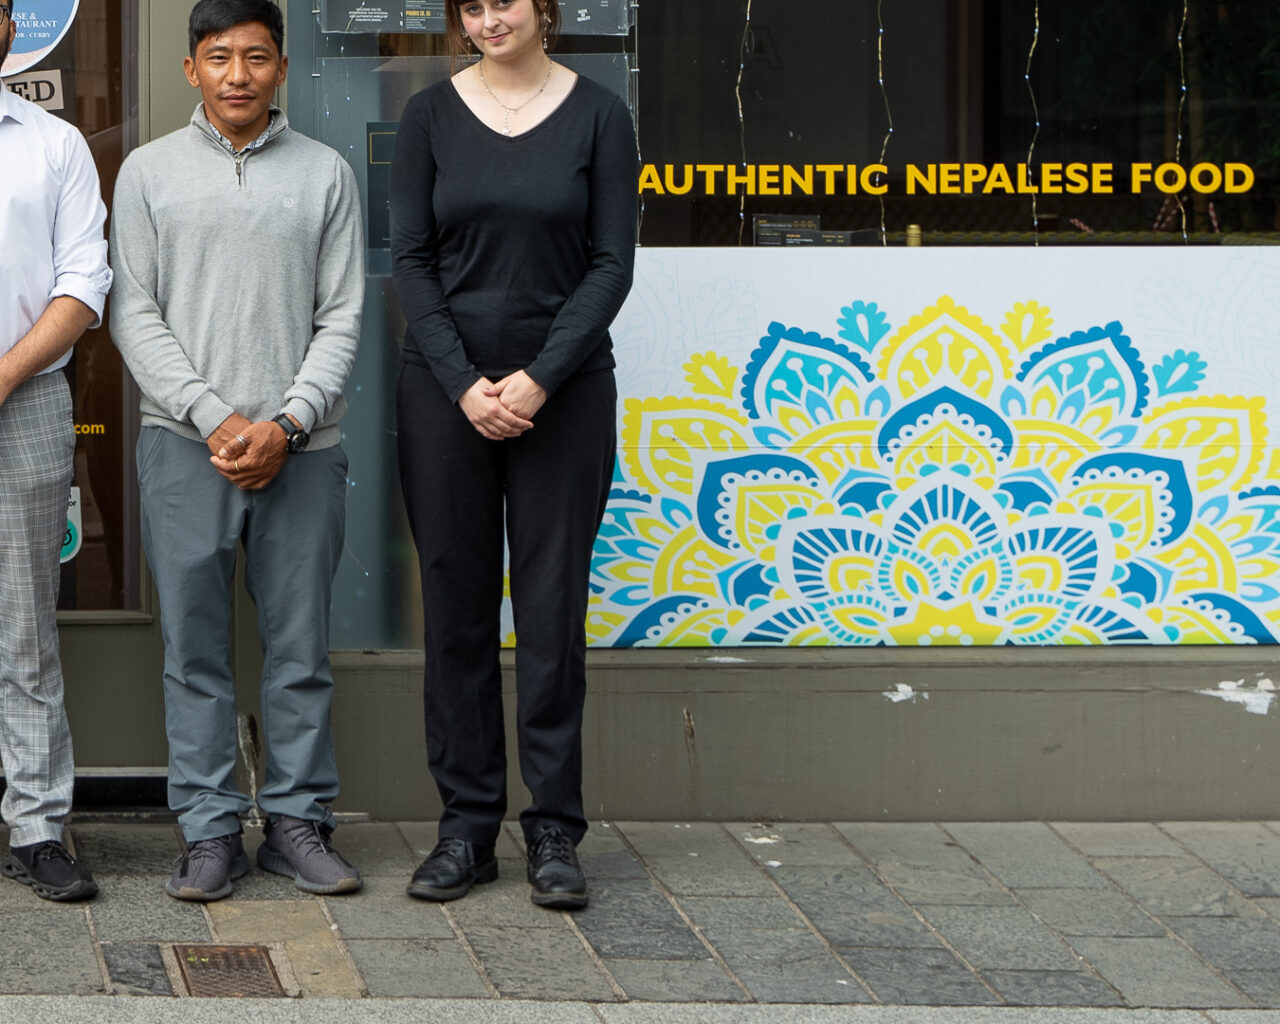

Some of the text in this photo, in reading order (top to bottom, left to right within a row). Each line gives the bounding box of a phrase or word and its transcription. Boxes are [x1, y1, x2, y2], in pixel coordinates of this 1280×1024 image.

[10, 11, 27, 20] ESE
[15, 20, 58, 28] TAURANT
[7, 79, 56, 103] ED
[638, 162, 1255, 195] AUTHENTIC NEPALESE FOOD
[73, 423, 105, 434] com
